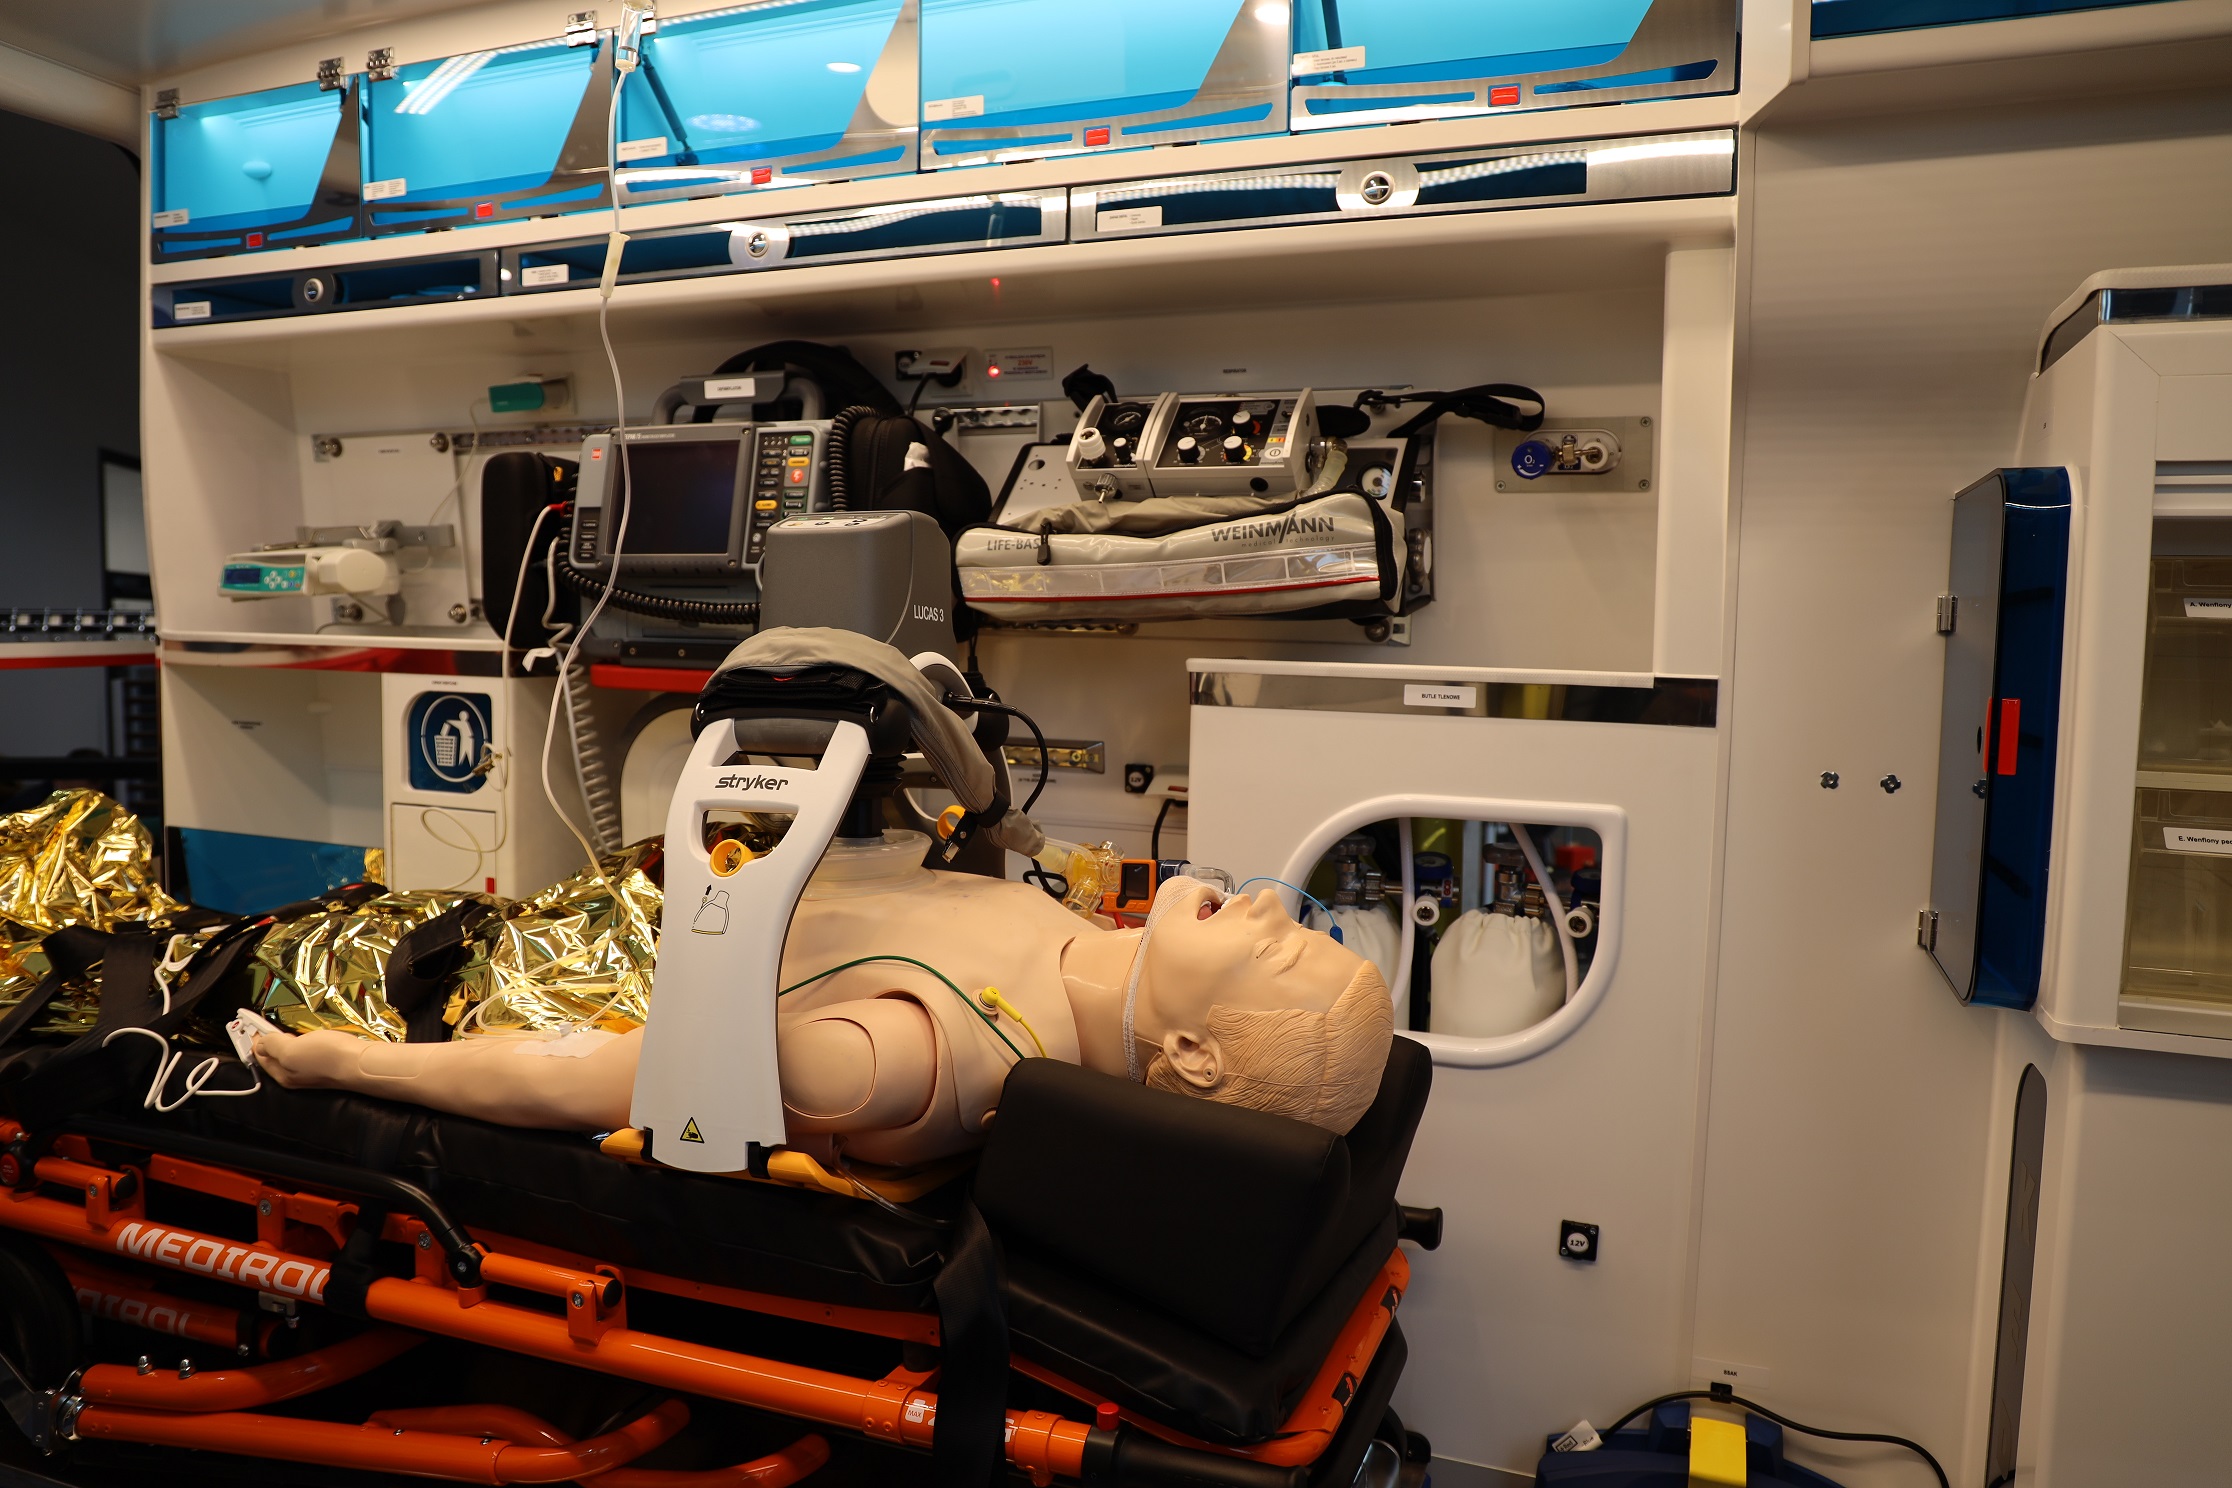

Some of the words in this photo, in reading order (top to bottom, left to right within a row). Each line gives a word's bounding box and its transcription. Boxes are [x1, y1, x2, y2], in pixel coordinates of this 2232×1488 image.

[1211, 511, 1335, 544] WEINMANN
[986, 538, 1041, 551] LIFE-BAS
[1241, 538, 1276, 547] medical
[1286, 535, 1335, 543] technology
[913, 604, 939, 621] LUCAS
[939, 608, 945, 622] 3
[715, 774, 789, 791] stryker
[2186, 836, 2220, 845] Wenflony
[1570, 1239, 1586, 1247] 12V
[907, 1409, 922, 1418] MAX
